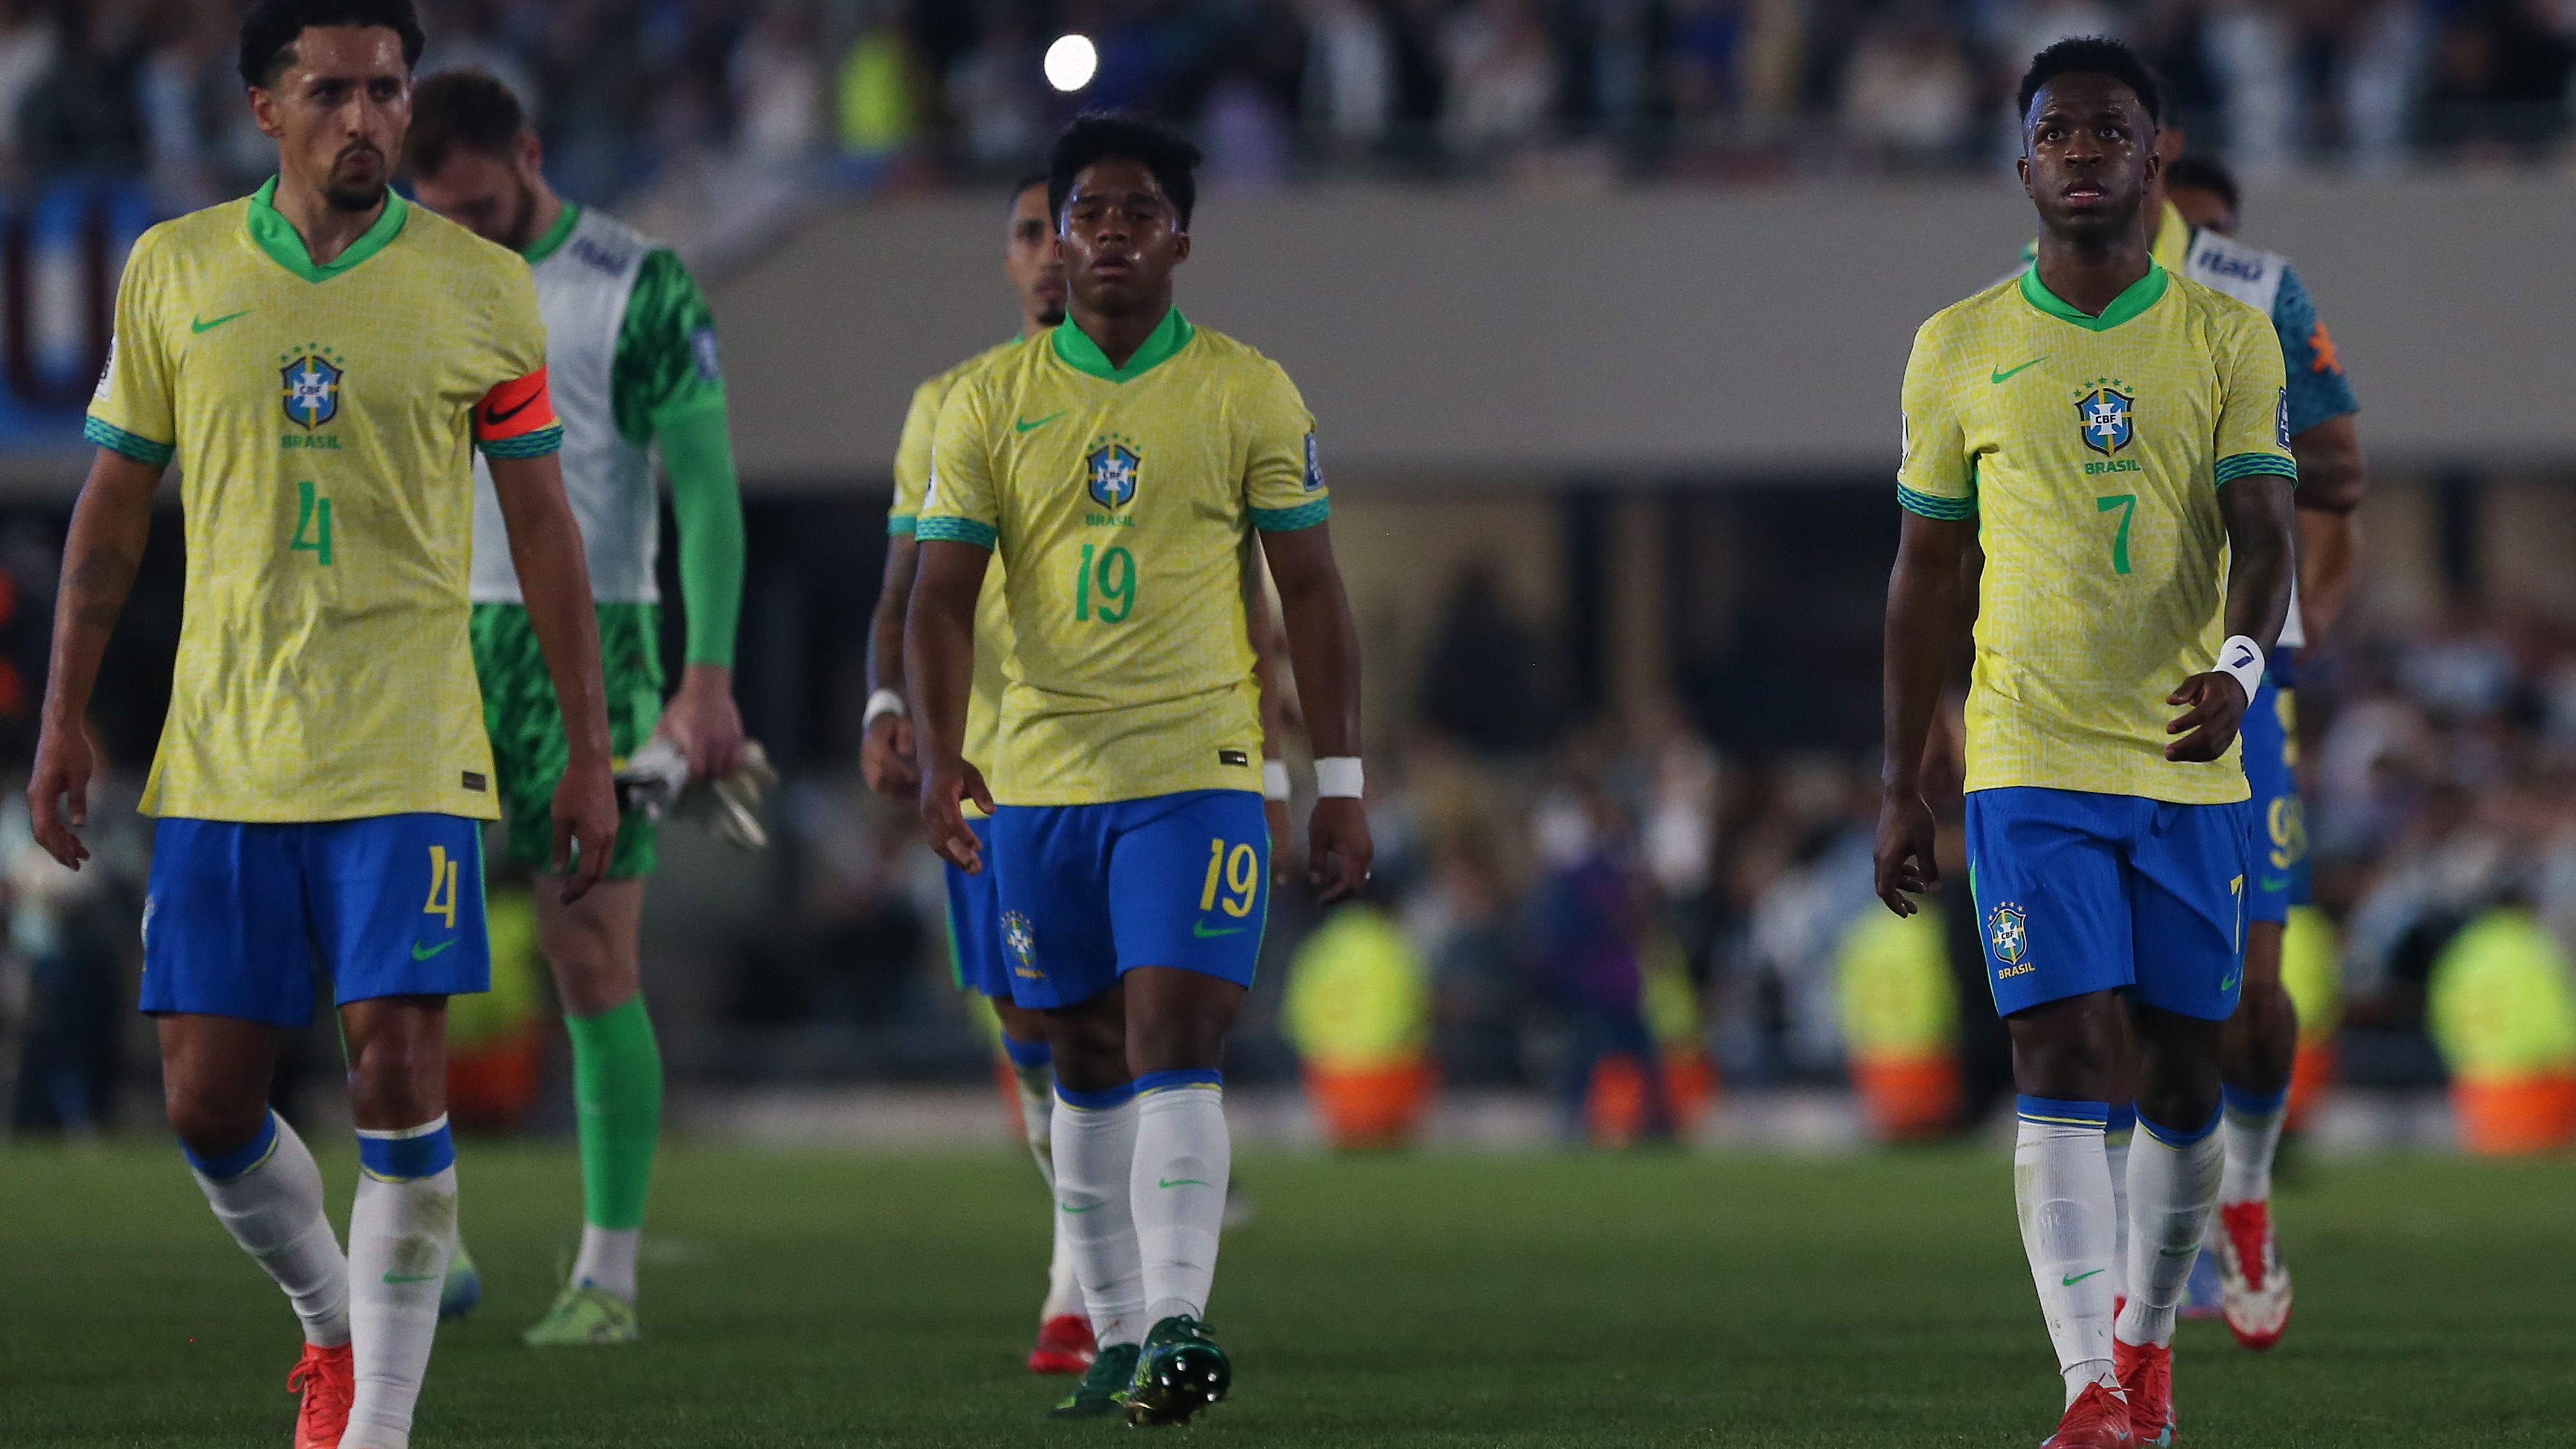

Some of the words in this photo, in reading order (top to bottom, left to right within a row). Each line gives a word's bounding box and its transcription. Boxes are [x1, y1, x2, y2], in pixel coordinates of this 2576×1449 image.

[2096, 414, 2117, 424] CBF
[2085, 459, 2141, 475] BRASIL
[290, 482, 332, 567] 4
[2097, 494, 2137, 574] 7
[1075, 544, 1137, 624] 19
[2231, 645, 2255, 669] 7
[423, 845, 457, 929] 4
[1200, 838, 1258, 918] 19
[2001, 931, 2014, 940] CBF
[1998, 962, 2036, 980] BRASIL
